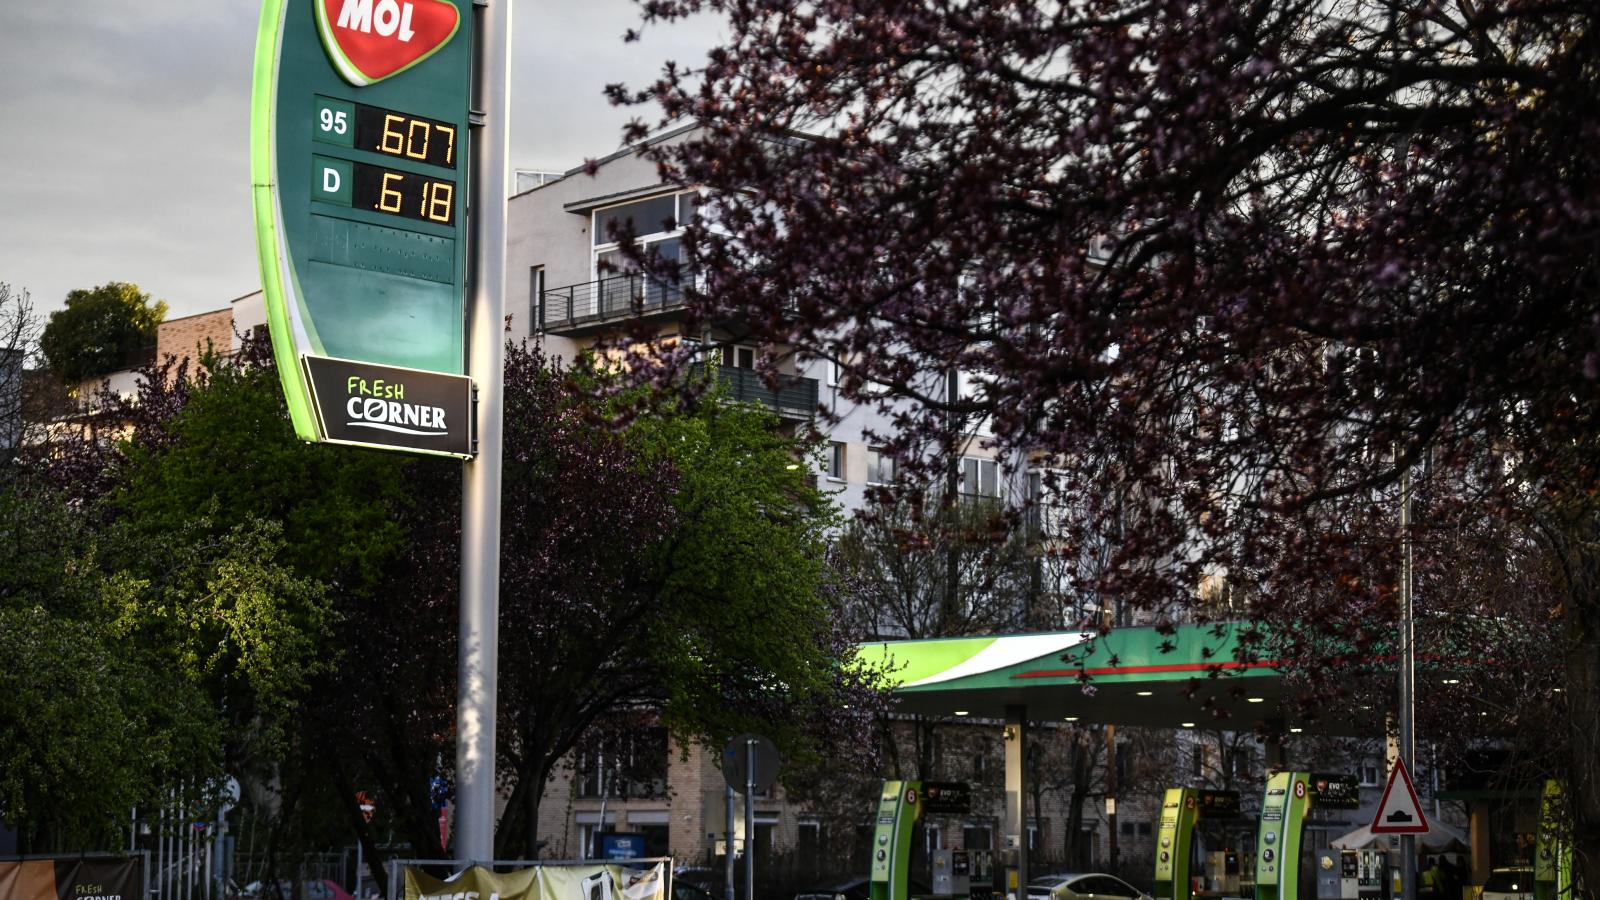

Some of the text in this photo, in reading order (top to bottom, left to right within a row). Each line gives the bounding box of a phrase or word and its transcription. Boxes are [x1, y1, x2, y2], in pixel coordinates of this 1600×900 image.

[336, 0, 416, 42] MOL
[320, 108, 347, 134] 95
[323, 167, 341, 192] D
[347, 376, 404, 399] FRESH
[346, 396, 447, 429] CORNER
[908, 790, 915, 803] 6
[1296, 782, 1304, 797] 8
[1187, 797, 1194, 808] 2
[75, 884, 102, 894] FRESH
